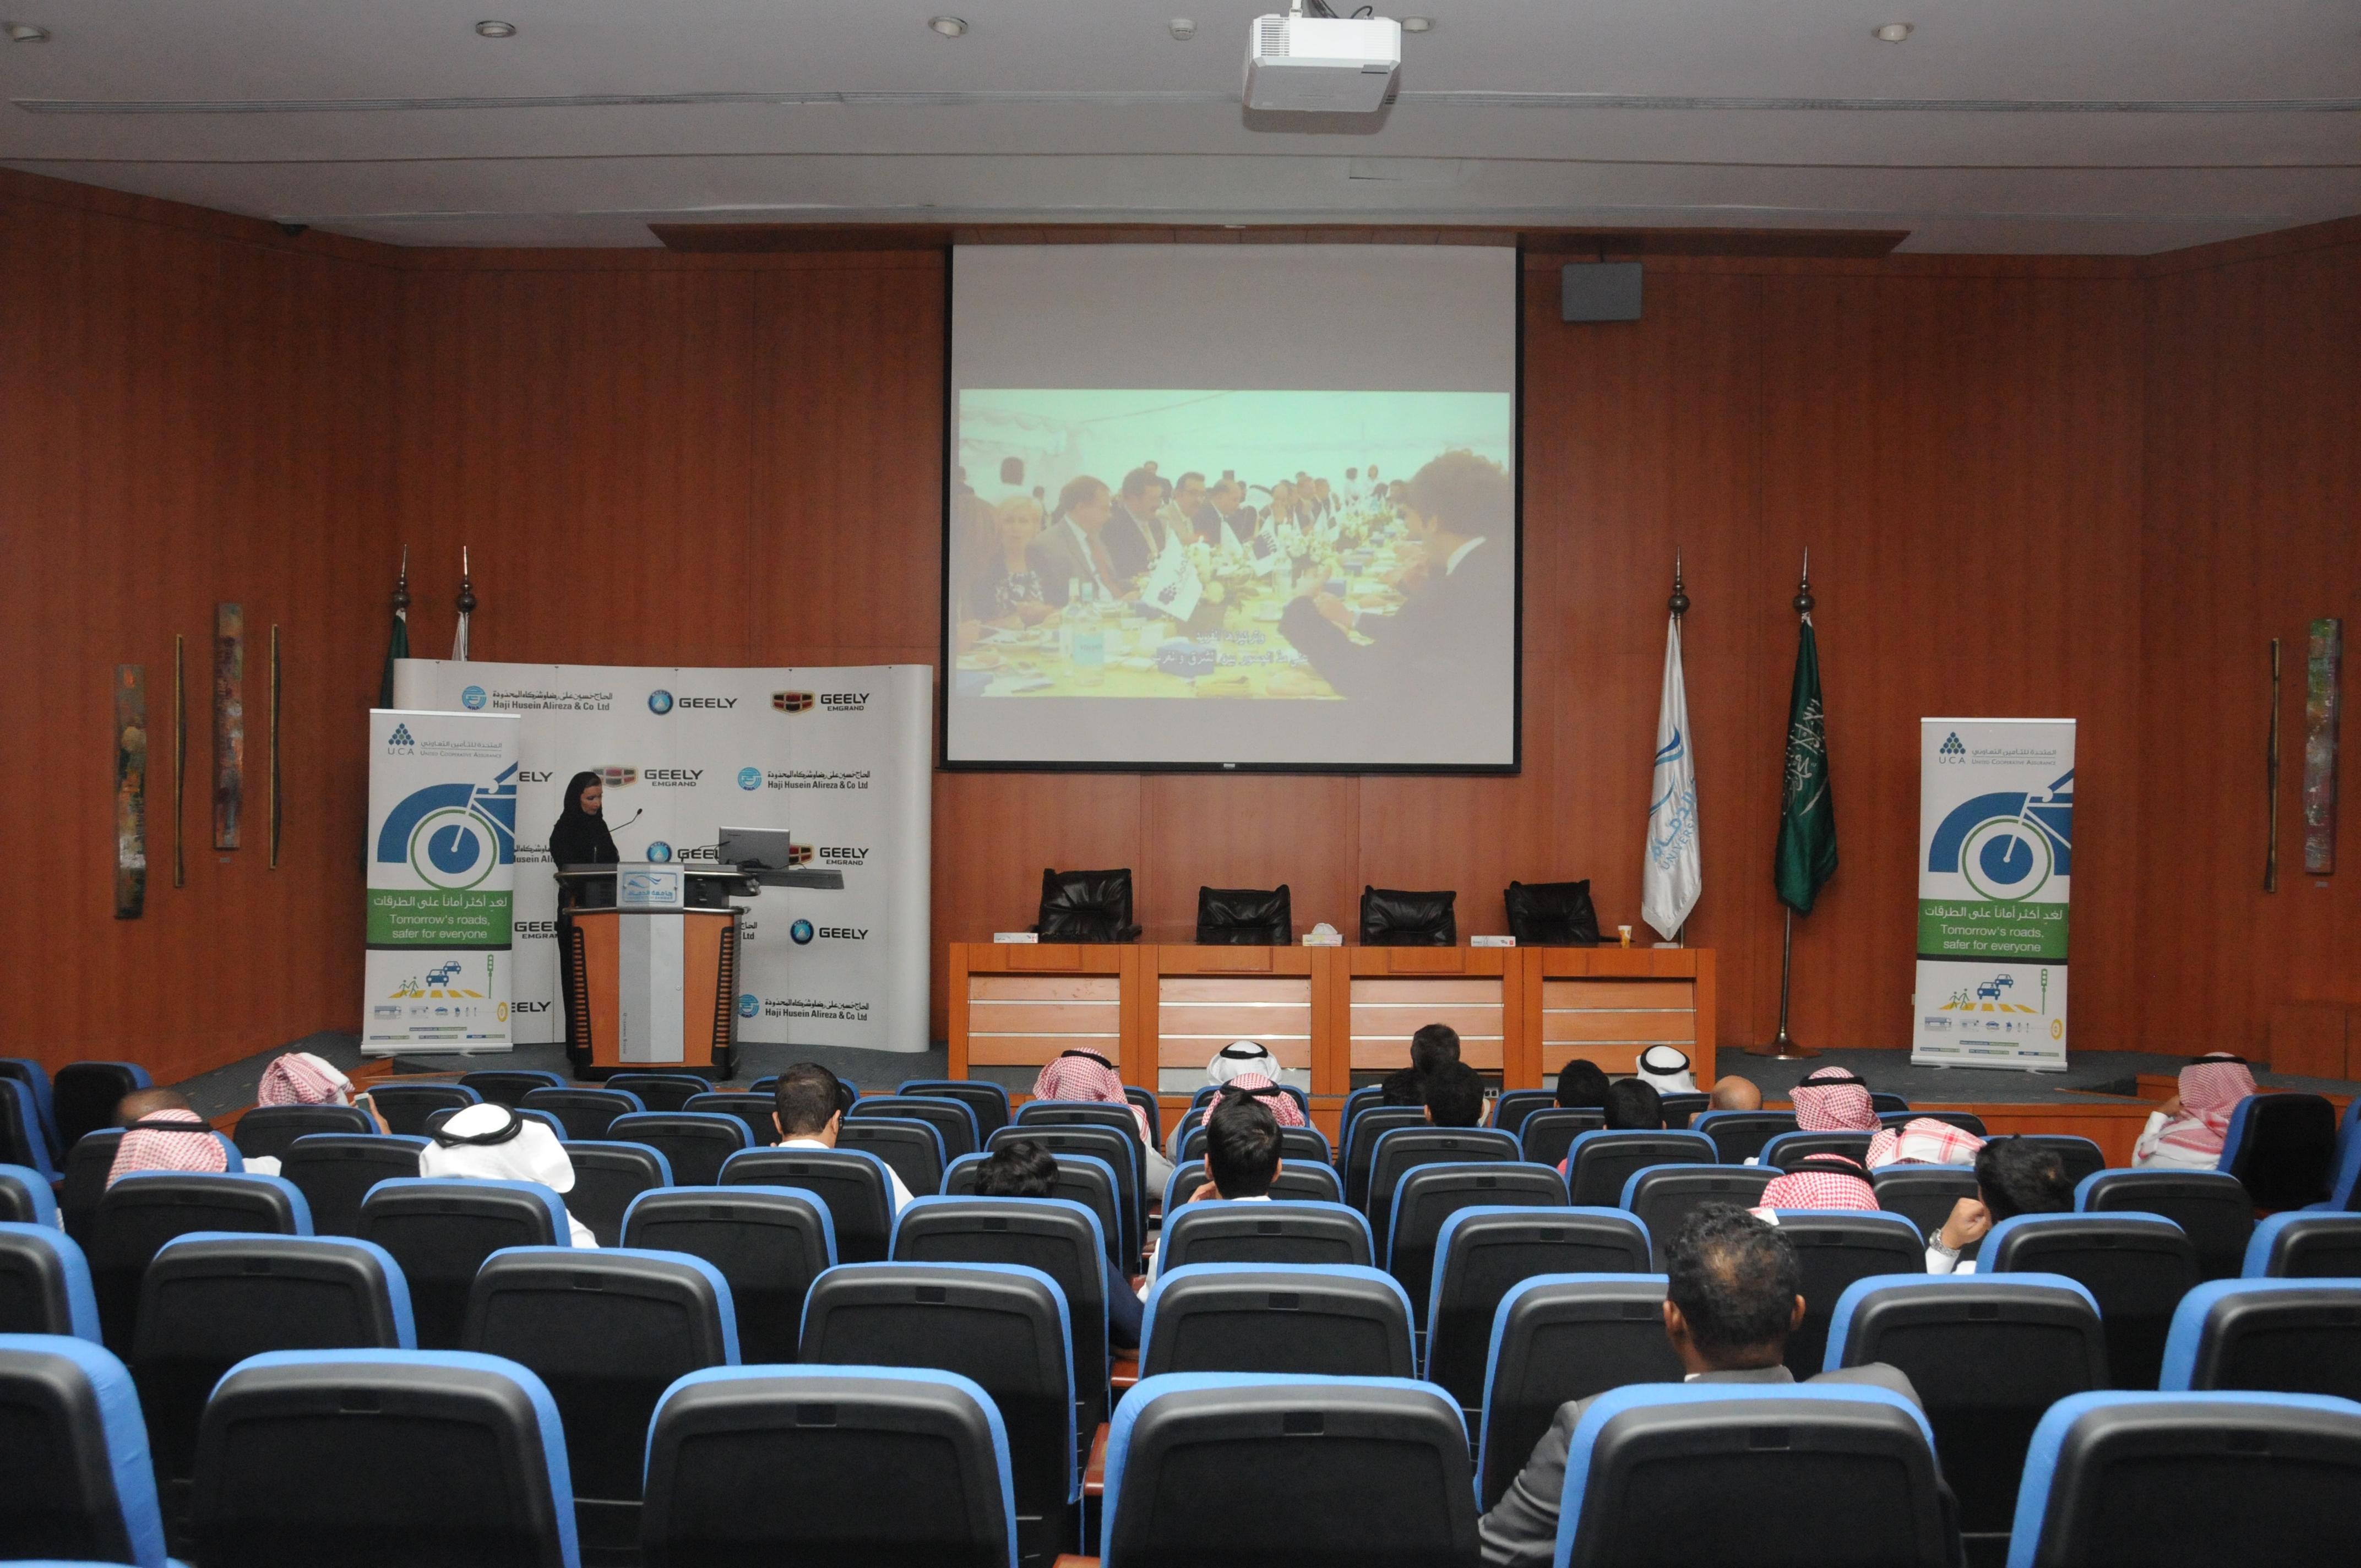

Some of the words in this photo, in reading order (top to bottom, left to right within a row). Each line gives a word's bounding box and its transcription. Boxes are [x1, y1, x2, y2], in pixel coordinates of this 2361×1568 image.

[679, 698, 738, 709] GEELY
[820, 693, 869, 704] GEELY
[493, 700, 510, 710] Haji
[512, 701, 541, 709] Husein
[542, 701, 572, 710] Alireza
[518, 771, 553, 782] ELY
[644, 769, 703, 780] GEELY
[768, 781, 783, 790] Haji
[812, 781, 838, 789] Alireza
[840, 781, 845, 789] &
[847, 781, 856, 789] Co
[858, 781, 868, 789] Ltd
[1660, 823, 1695, 870] UNIVERS
[820, 847, 869, 859] GEELY
[374, 896, 415, 908] الطرقات
[417, 897, 439, 908] على
[465, 895, 486, 909] أكثر
[1925, 906, 1966, 918] الطرقات
[1968, 907, 1991, 919] على
[2017, 907, 2039, 921] أكثر
[390, 914, 454, 924] Tomorrow's
[458, 916, 490, 925] roads,
[392, 929, 417, 938] safer
[422, 929, 436, 938] for
[440, 930, 487, 940] everyone
[743, 932, 754, 940] Ltd
[819, 927, 868, 939] GEELY
[1940, 924, 2006, 936] Tomorrow's
[2010, 928, 2044, 938] roads,
[1943, 940, 1970, 949] safer
[1973, 940, 1987, 950] for
[1991, 944, 2041, 953] everyone
[765, 1008, 781, 1017] Haji
[783, 1009, 809, 1017] Husein
[811, 1010, 837, 1019] Alireza
[846, 1011, 855, 1020] Co
[857, 1012, 867, 1021] Ltd
